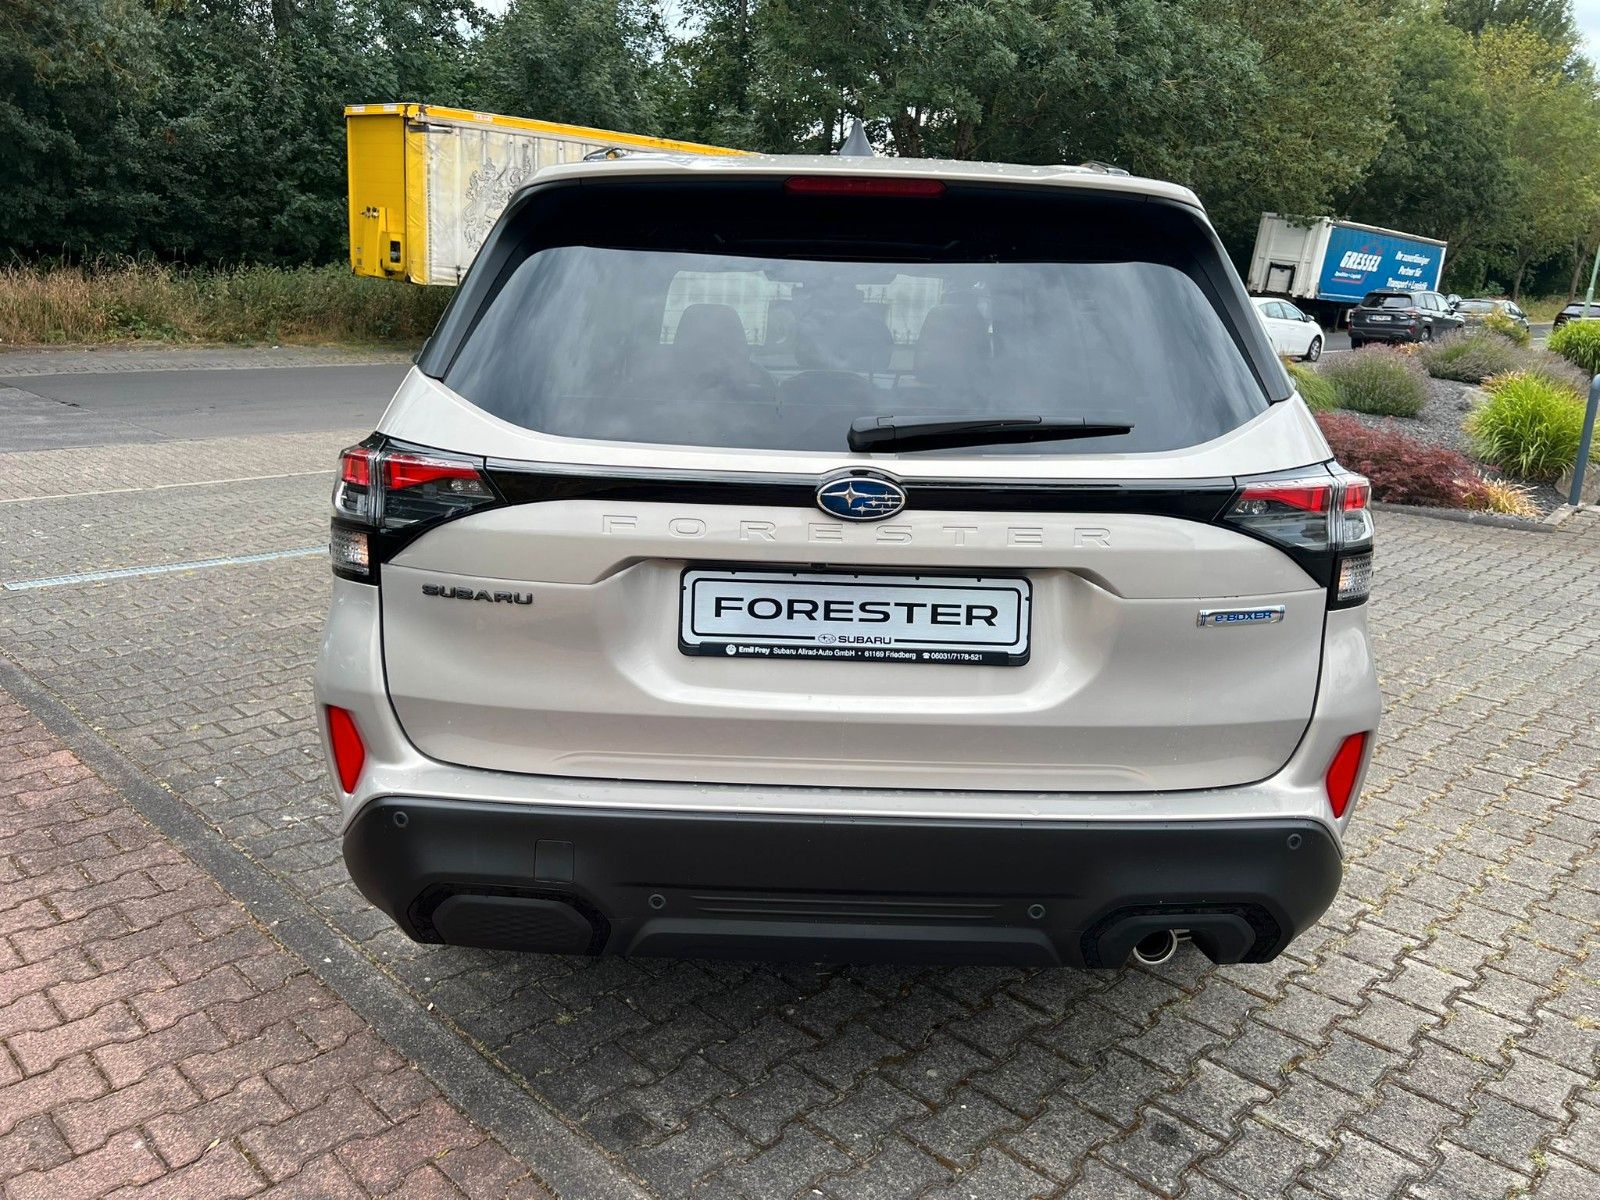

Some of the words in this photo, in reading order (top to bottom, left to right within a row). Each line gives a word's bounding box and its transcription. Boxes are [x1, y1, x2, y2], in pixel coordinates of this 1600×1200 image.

[1340, 251, 1382, 272] GRESSEL
[602, 514, 1112, 548] FORESTER
[422, 583, 533, 604] SUBARU
[714, 597, 999, 627] FORESTER
[1215, 610, 1272, 622] e-BOXER
[838, 635, 892, 645] SUBARU
[738, 646, 754, 655] Emil
[755, 647, 770, 656] Frey
[773, 647, 797, 655] Subaru
[797, 647, 833, 656] Allrad-Auto
[834, 649, 856, 657] GmbH
[864, 650, 884, 658] 61169
[885, 650, 917, 660] Friedberg
[931, 653, 983, 661] 06031/7178-521
